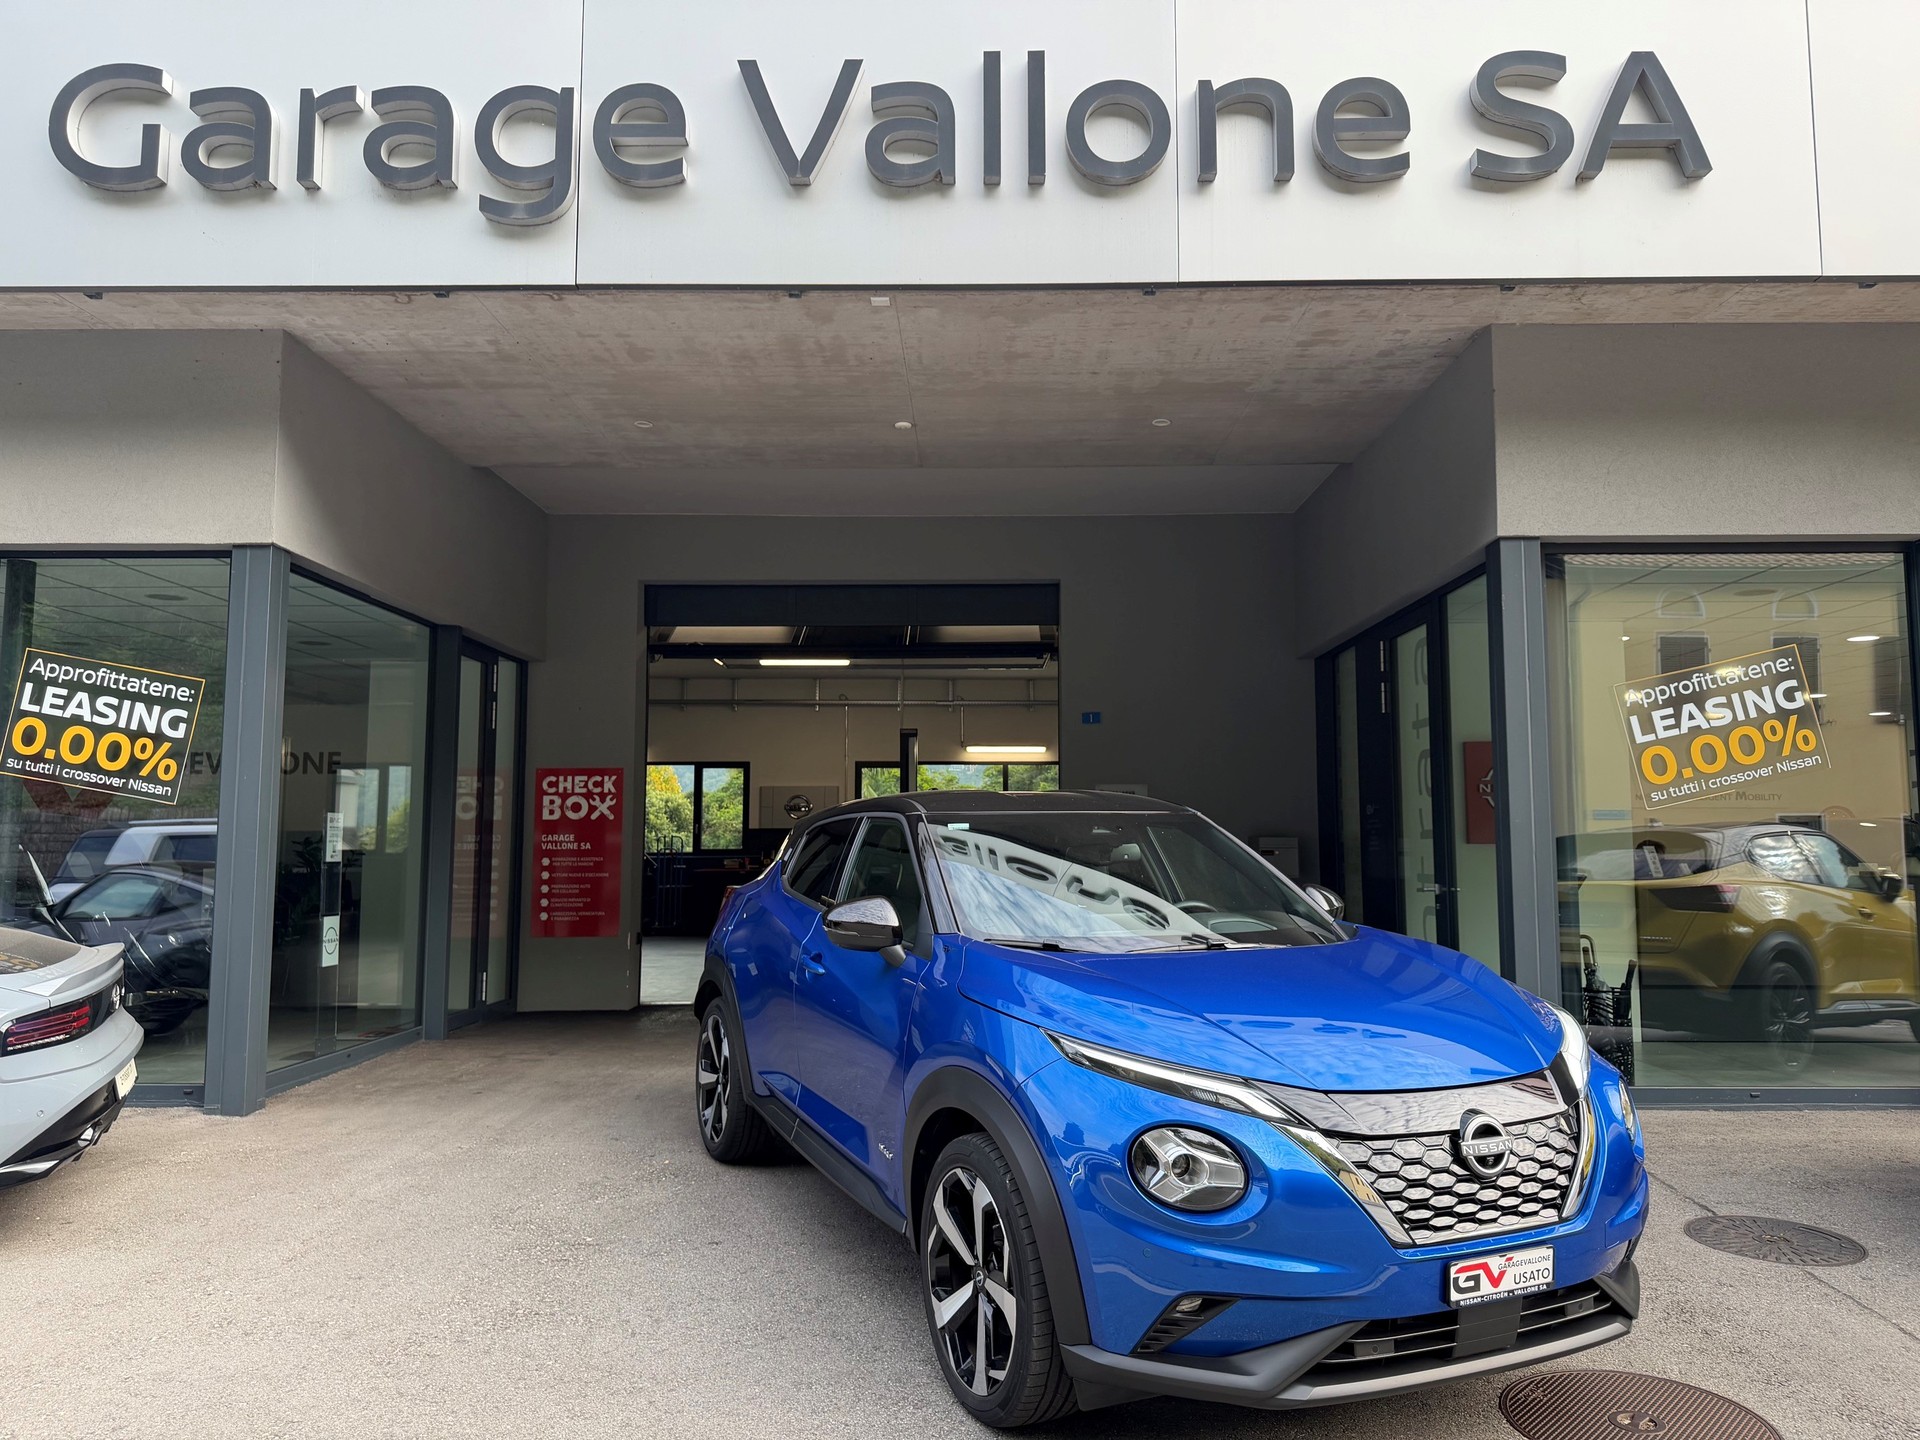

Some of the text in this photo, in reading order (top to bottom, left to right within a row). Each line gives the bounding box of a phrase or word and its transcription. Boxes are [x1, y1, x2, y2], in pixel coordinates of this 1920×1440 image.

[48, 50, 1713, 228] Garage Vallone SA
[29, 657, 195, 702] Approfittatene:
[1626, 657, 1795, 708] Approfittatene:
[20, 682, 189, 739] LEASING
[1089, 713, 1094, 723] 1
[1629, 679, 1805, 744] LEASING
[12, 716, 178, 782] 0.00%
[1640, 715, 1817, 785] 0.00%
[6, 758, 172, 797] su tutti i crossover Nissan
[542, 775, 617, 794] CHECK
[1650, 789, 1668, 802] su
[1669, 780, 1699, 798] tutti
[1700, 780, 1706, 791] i
[1708, 765, 1774, 789] crossover
[1776, 754, 1822, 774] Nissan
[541, 794, 617, 821] BOX
[541, 834, 575, 842] GARAGE
[541, 842, 591, 850] VALLONE SA
[1463, 1140, 1512, 1155] NISSAN
[1498, 1254, 1551, 1271] GARAGEVALLONE
[1513, 1268, 1551, 1285] USATO
[1514, 1286, 1538, 1296] VALLONE
